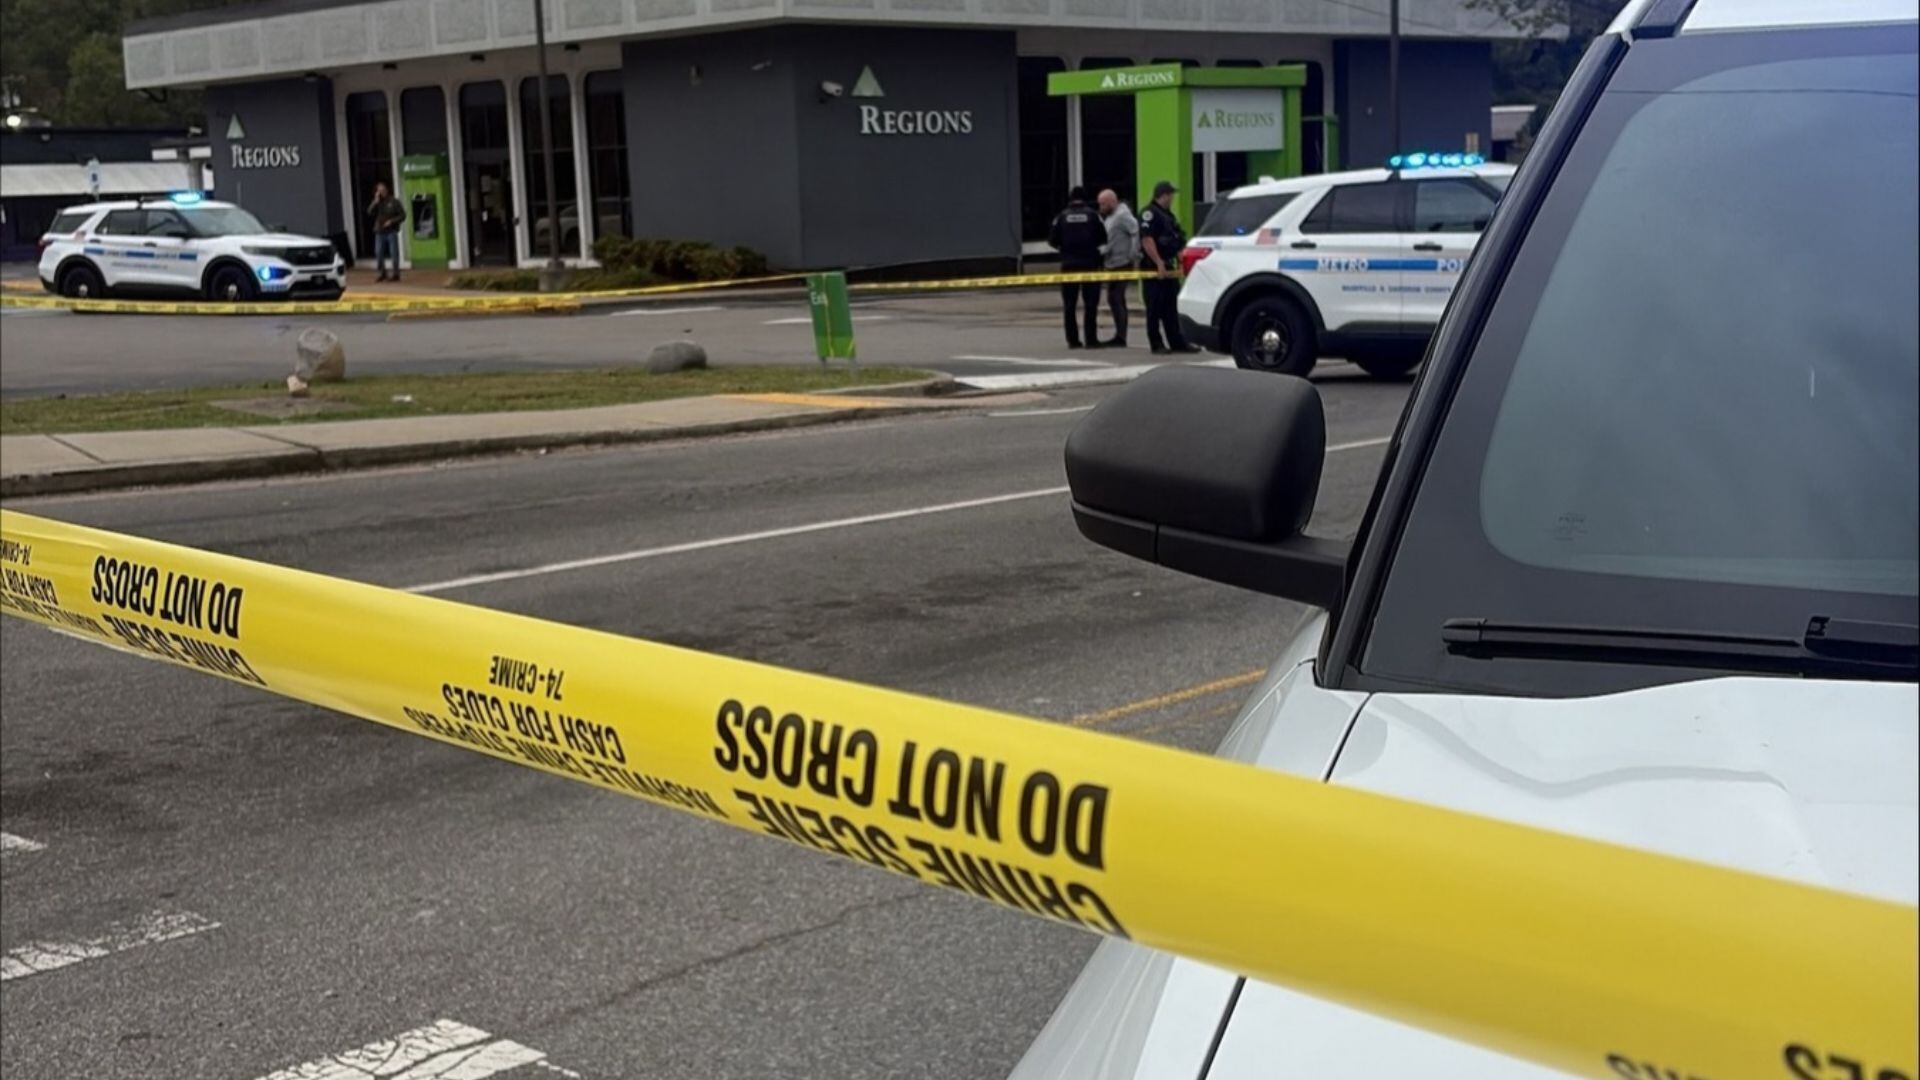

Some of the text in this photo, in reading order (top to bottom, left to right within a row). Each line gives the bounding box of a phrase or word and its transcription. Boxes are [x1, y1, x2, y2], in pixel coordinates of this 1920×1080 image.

[1117, 71, 1175, 88] REGIONS
[860, 105, 973, 135] REGIONS
[1215, 109, 1276, 129] REGIONS
[231, 144, 301, 169] REGIONS
[1317, 258, 1370, 272] METRO
[91, 555, 159, 617] CROSS
[159, 571, 207, 630] NOT
[207, 582, 244, 640] DO
[102, 613, 268, 687] CRIME SCENE
[489, 655, 565, 701] 74-CRIME
[442, 683, 626, 765] CASH FOR CLUES
[714, 699, 1110, 873] DO NOT CROSS
[905, 836, 1133, 941] CRIME
